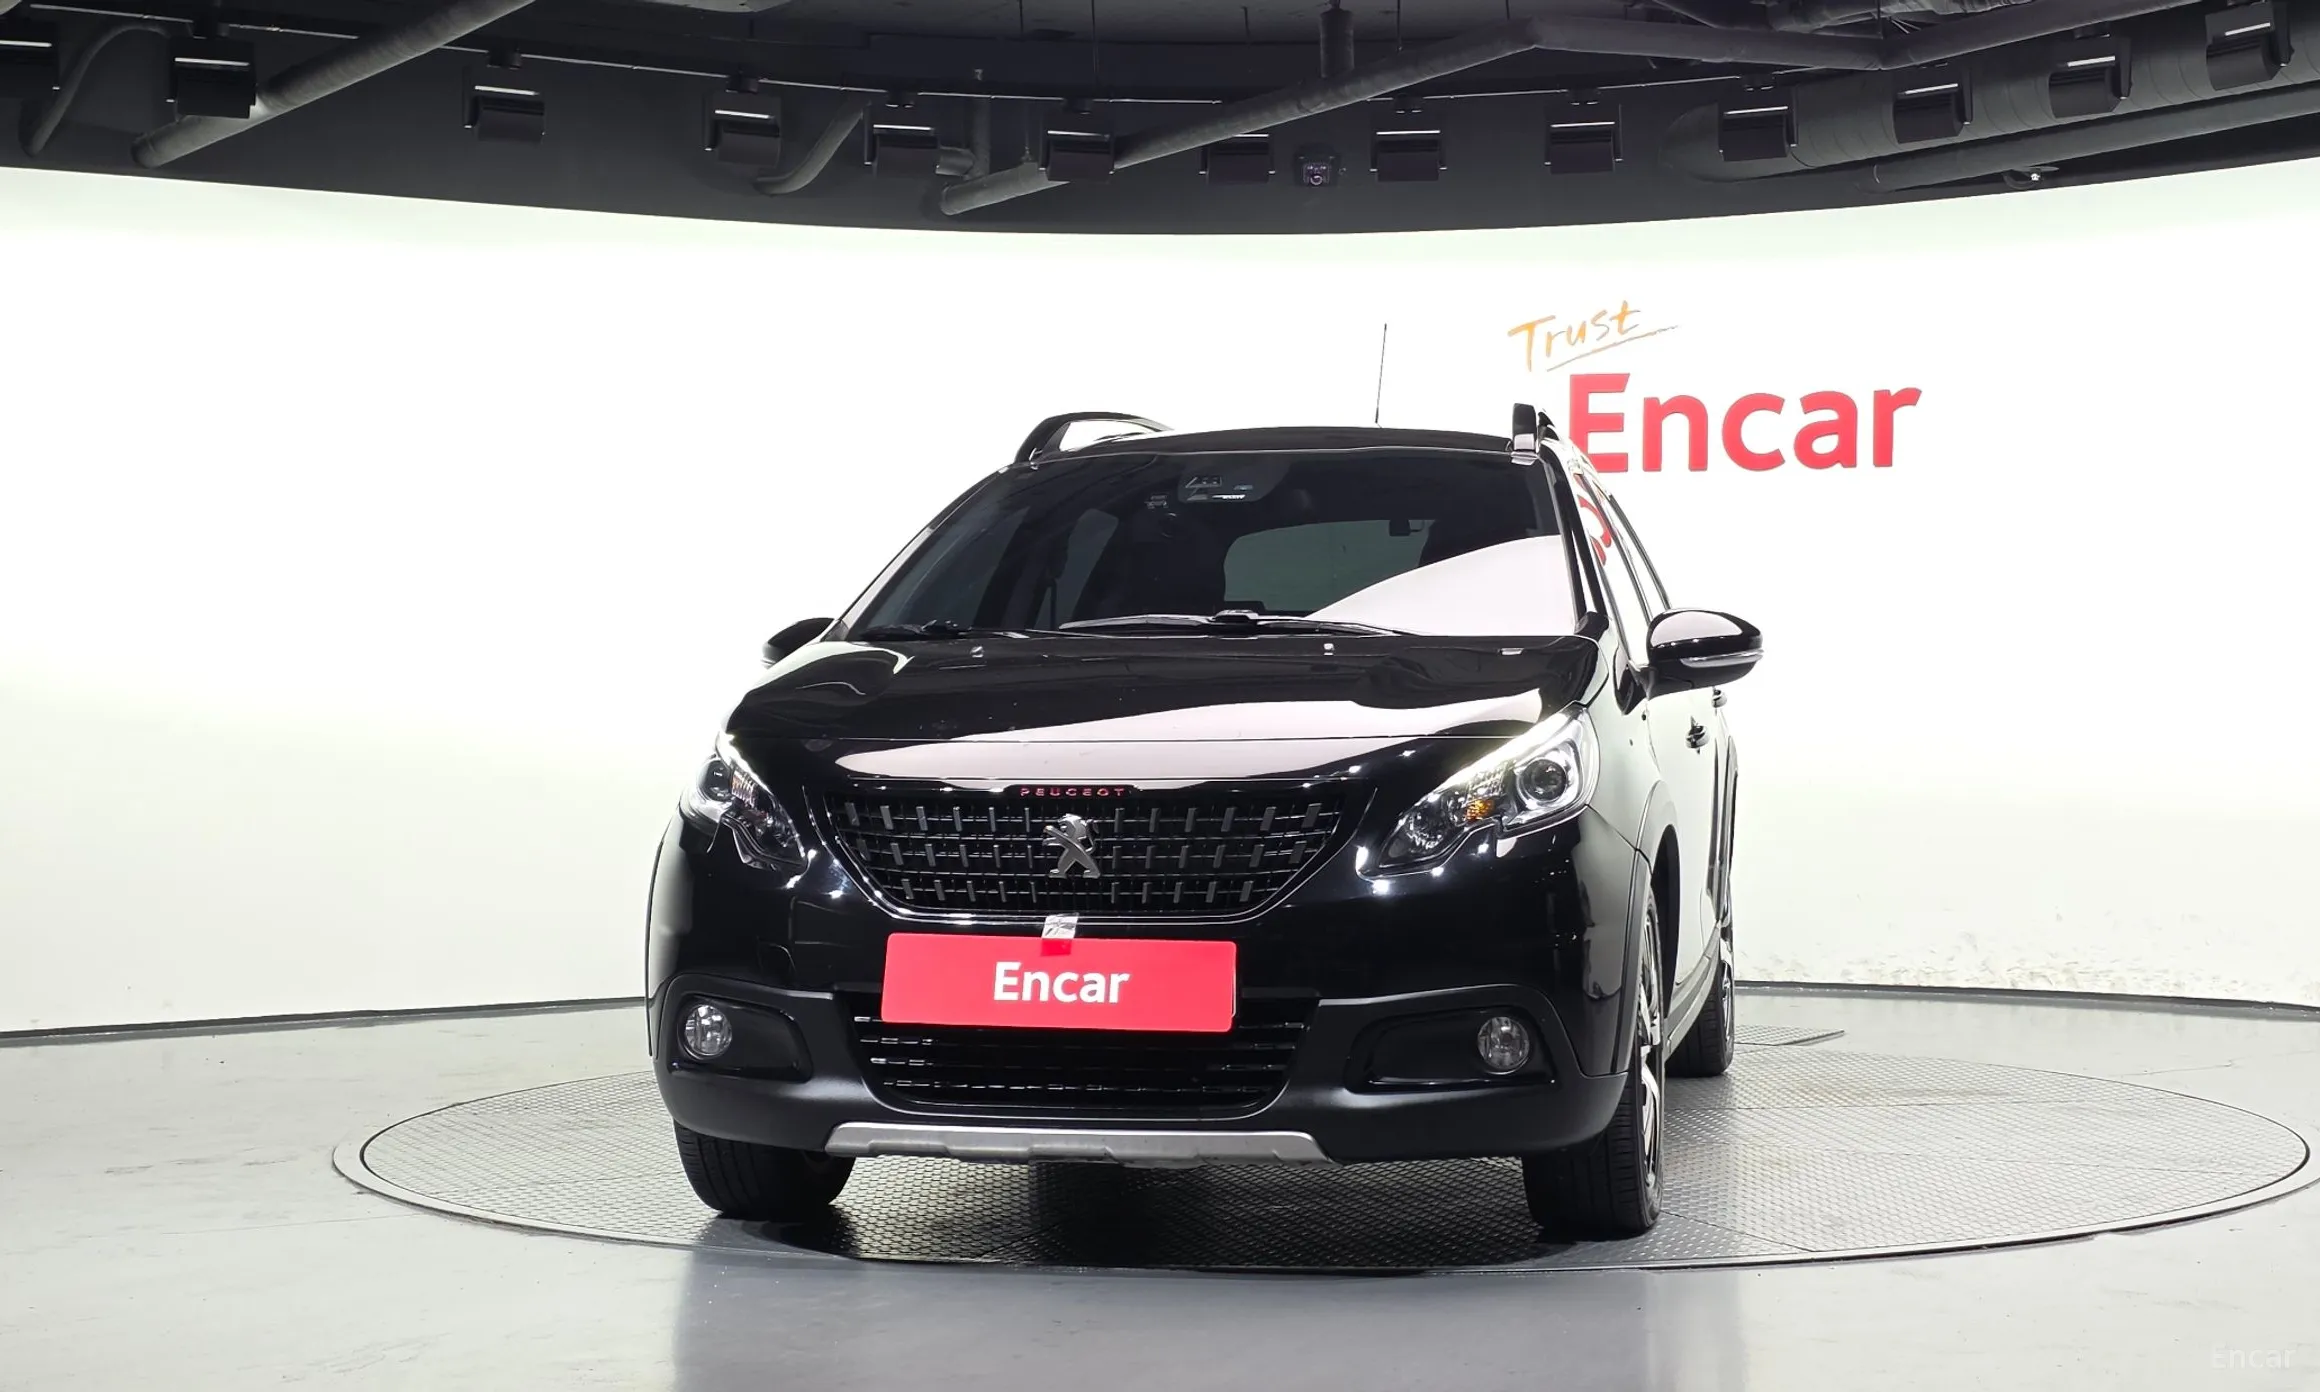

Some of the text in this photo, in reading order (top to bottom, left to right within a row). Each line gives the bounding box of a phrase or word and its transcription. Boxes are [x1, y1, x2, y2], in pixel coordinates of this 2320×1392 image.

[1507, 300, 1642, 372] Trust
[1569, 373, 1922, 473] Encar
[1020, 787, 1125, 797] PEUGEOT
[993, 961, 1130, 1003] Encar
